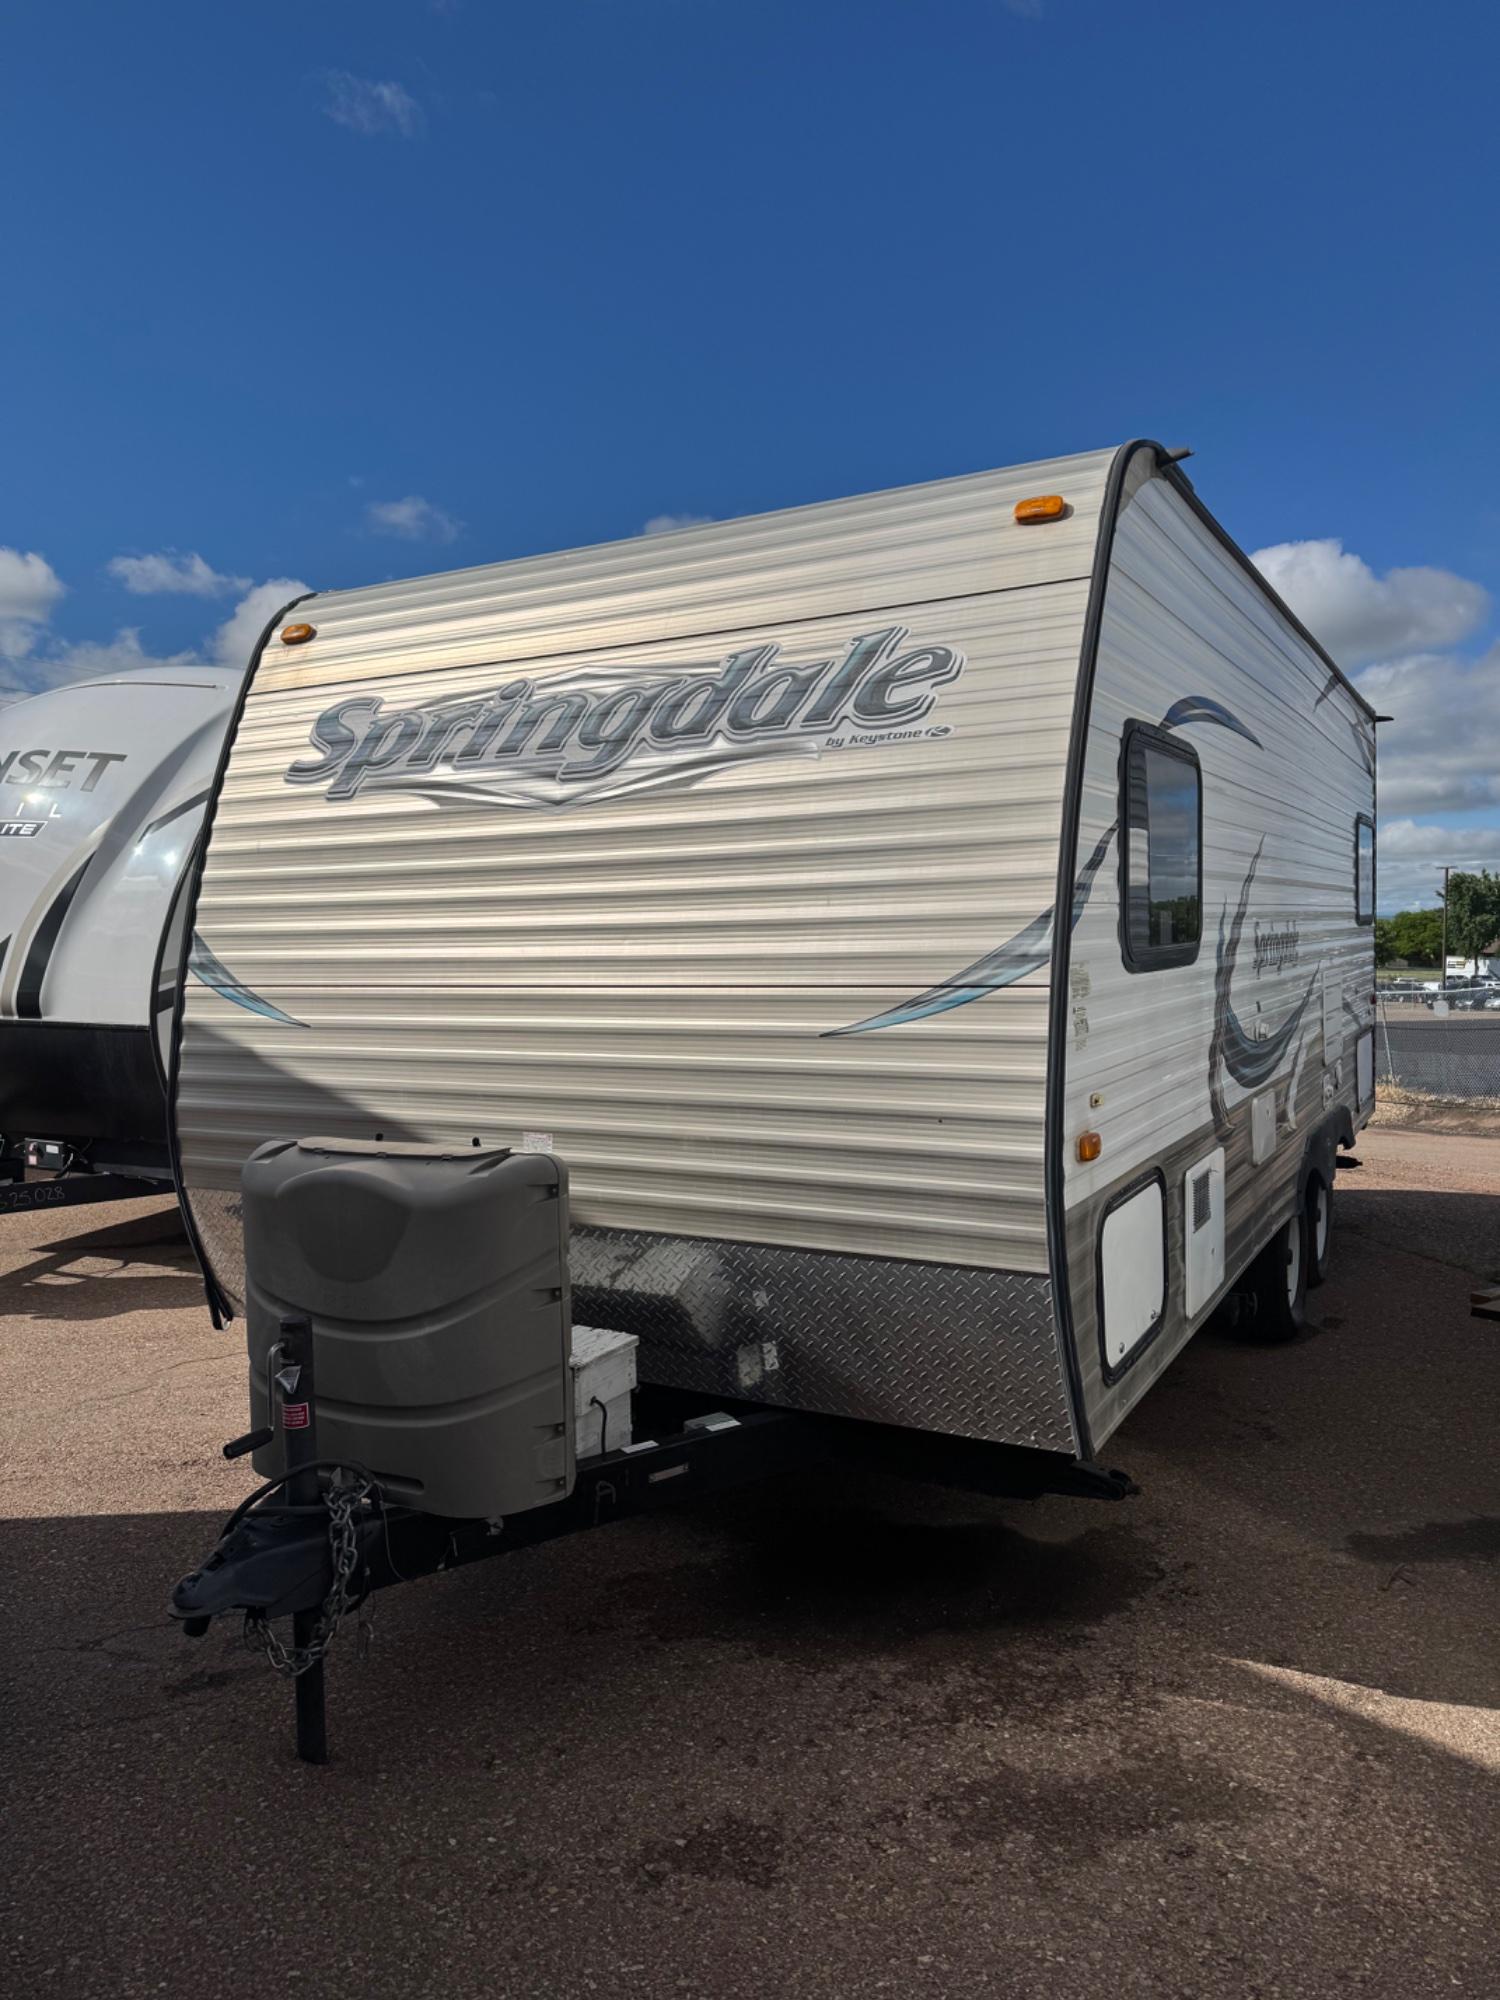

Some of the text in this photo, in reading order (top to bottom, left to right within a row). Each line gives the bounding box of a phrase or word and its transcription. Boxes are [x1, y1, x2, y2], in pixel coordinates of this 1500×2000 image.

[285, 626, 964, 801] Springdale
[825, 730, 922, 748] by Keystone
[0, 823, 37, 835] ITE
